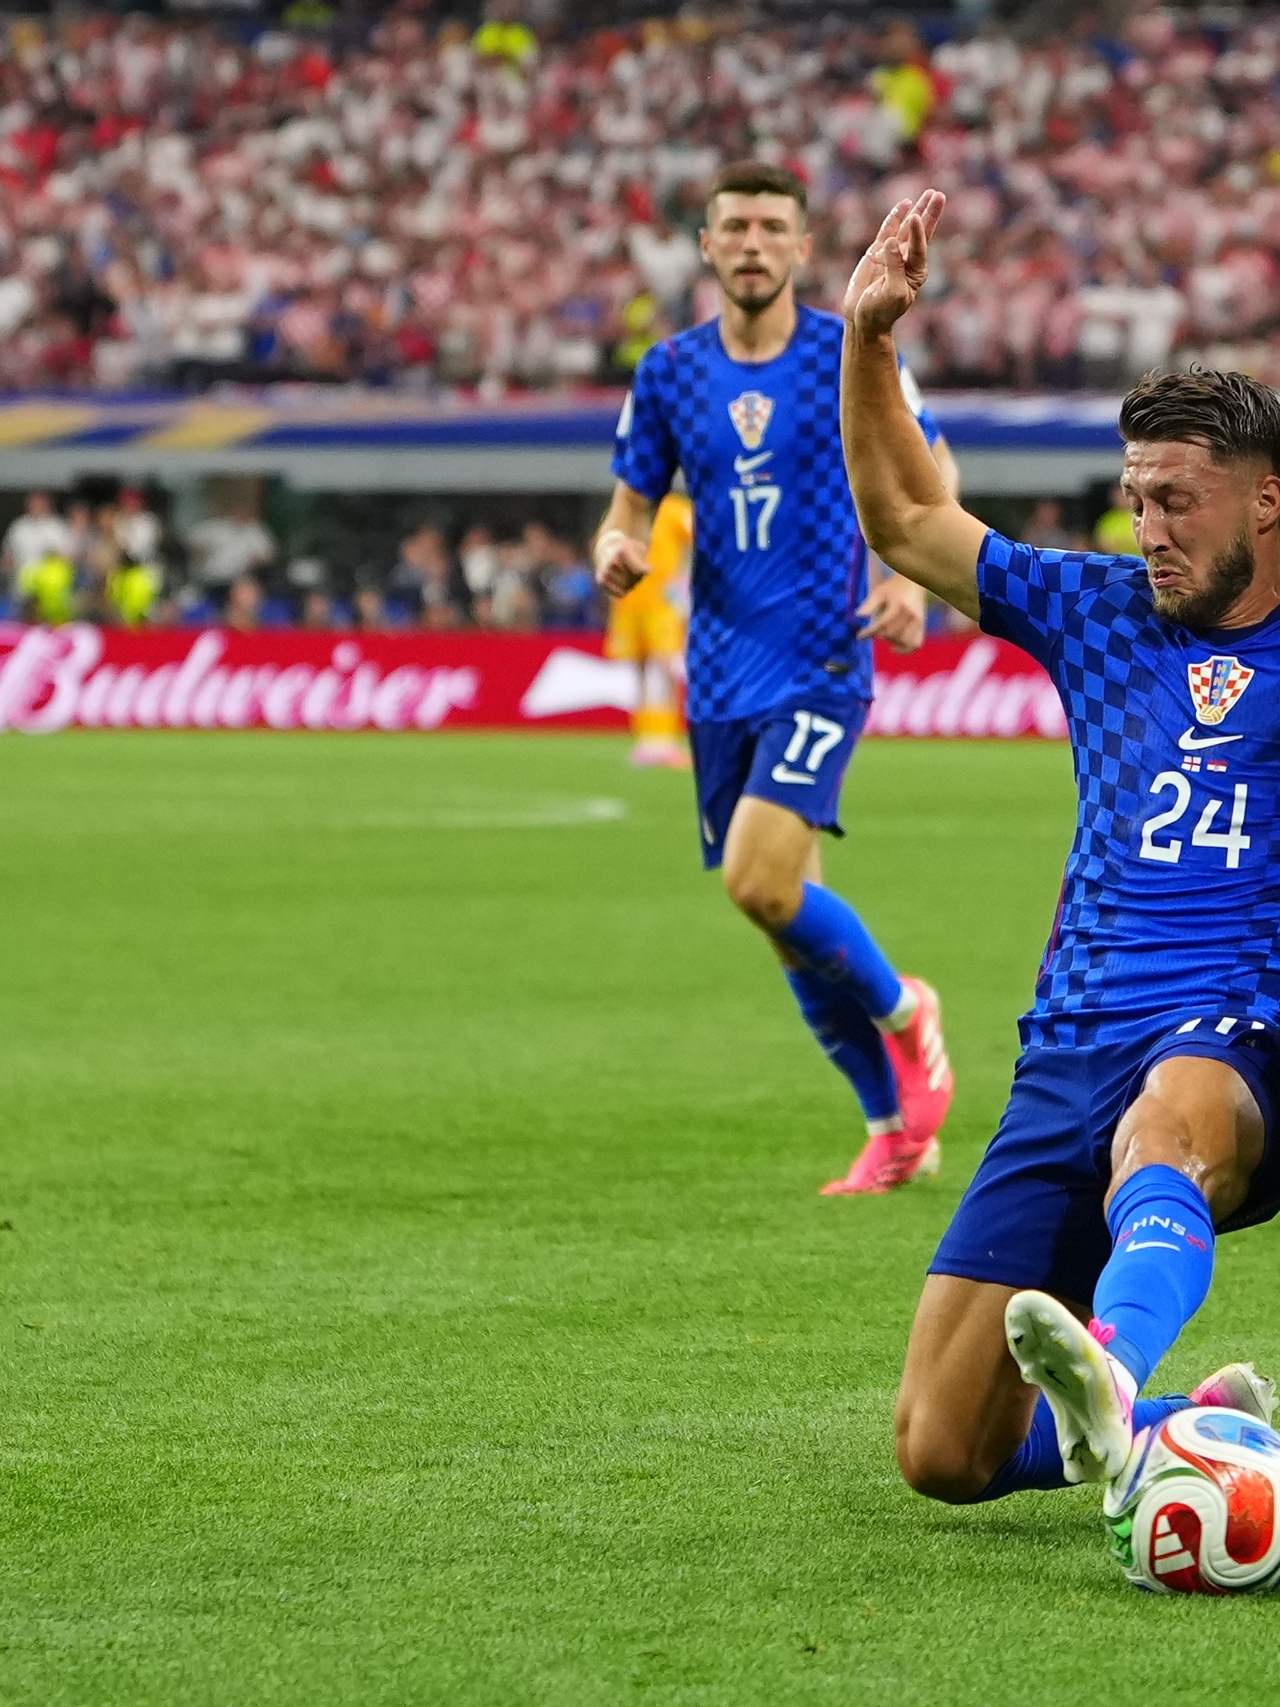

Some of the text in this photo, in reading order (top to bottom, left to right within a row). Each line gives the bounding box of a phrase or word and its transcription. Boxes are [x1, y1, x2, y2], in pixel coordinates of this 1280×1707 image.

[728, 484, 781, 551] 17
[0, 622, 478, 735] Budweiser
[783, 709, 845, 772] 17
[1139, 771, 1250, 869] 24
[1132, 1214, 1187, 1236] HNS
